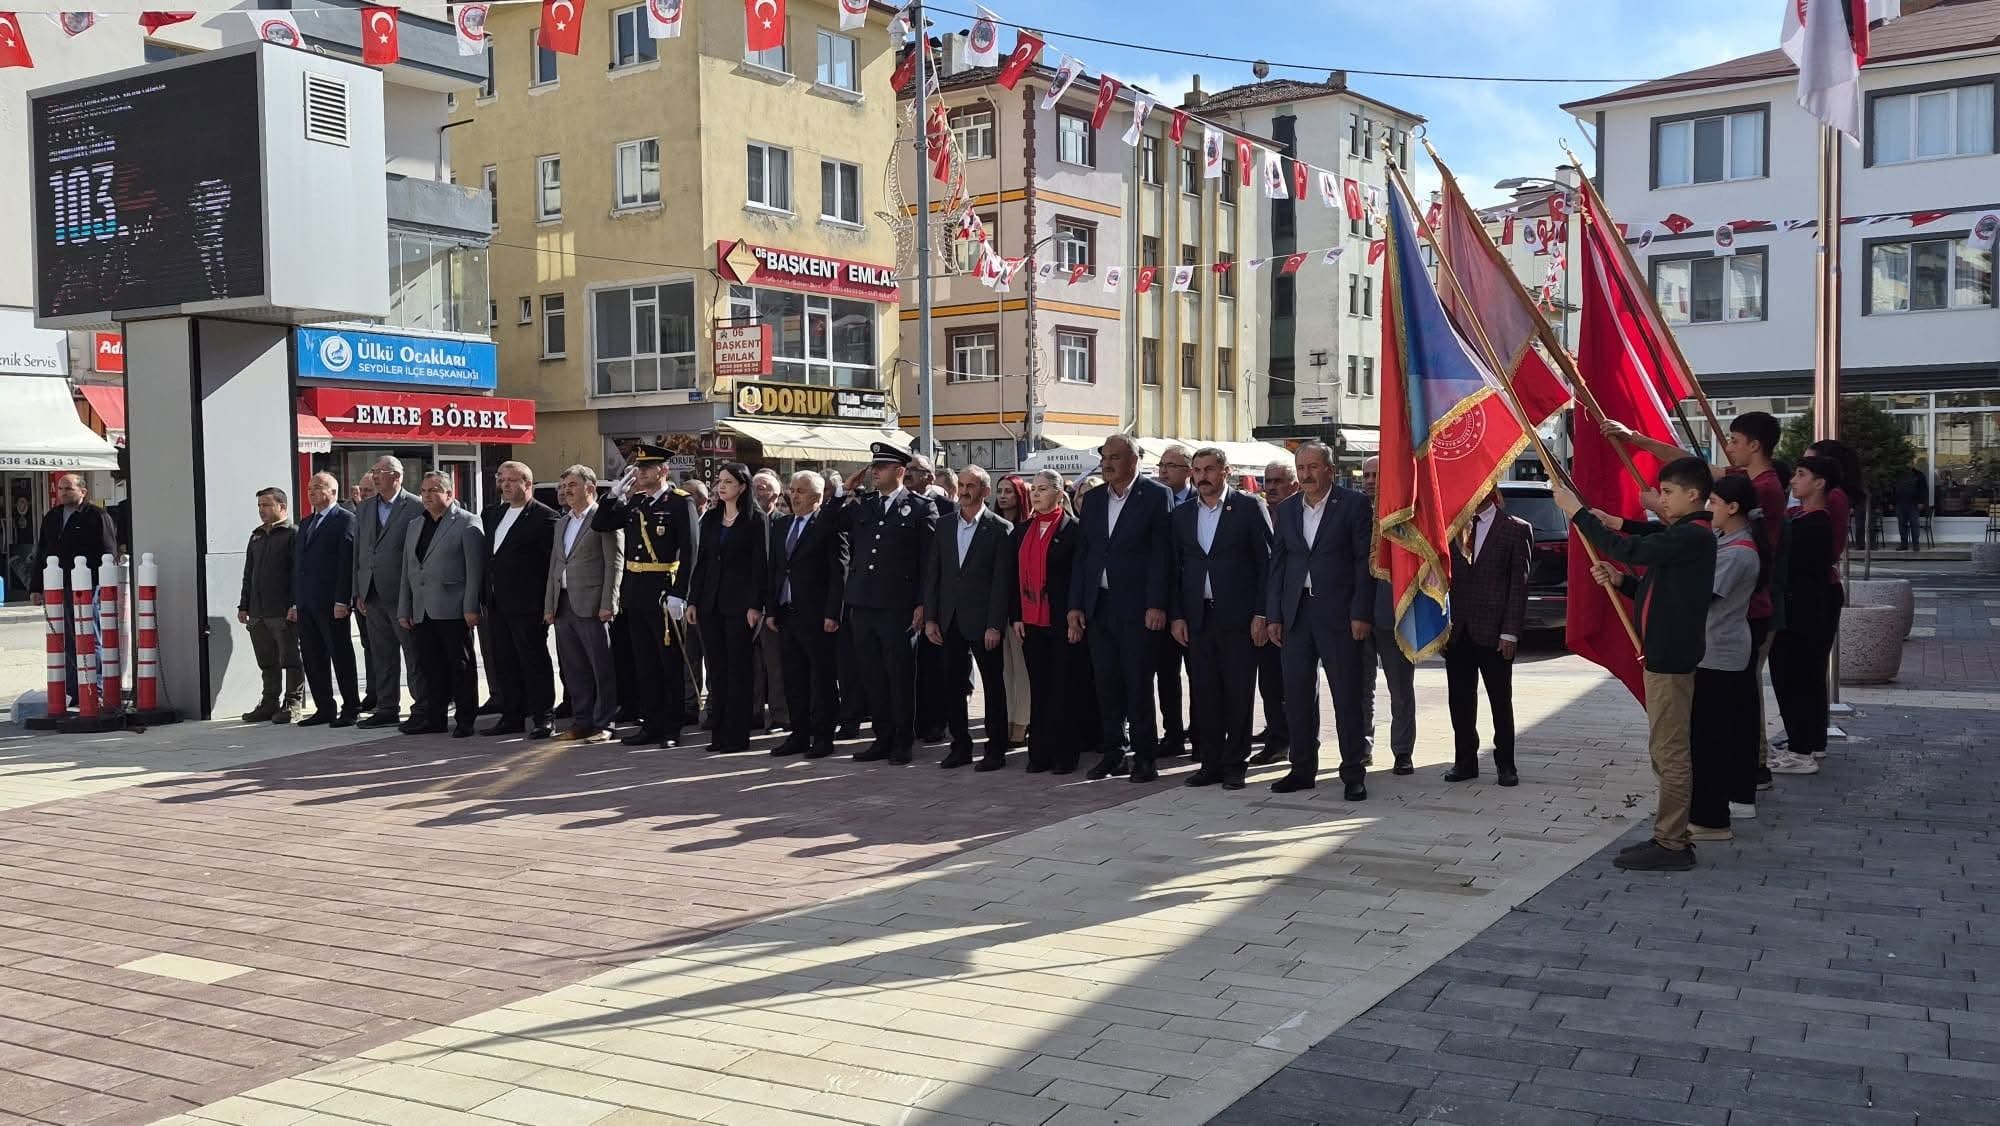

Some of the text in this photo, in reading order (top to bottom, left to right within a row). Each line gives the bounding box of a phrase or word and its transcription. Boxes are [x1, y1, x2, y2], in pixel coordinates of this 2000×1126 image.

[755, 247, 767, 259] 06
[767, 252, 840, 279] BAŞKENT
[848, 264, 900, 288] EMLAK
[732, 327, 744, 337] 06
[357, 339, 394, 362] Ülkü
[716, 339, 761, 351] BAŞKENT
[0, 352, 57, 369] nik Servis
[721, 353, 755, 362] EMLAK
[358, 363, 479, 381] SEYDİLER İLÇE BAŞKANLIĞI
[761, 387, 835, 416] DORUK
[356, 403, 510, 429] EMRE BÖREK
[25, 457, 46, 465] 458
